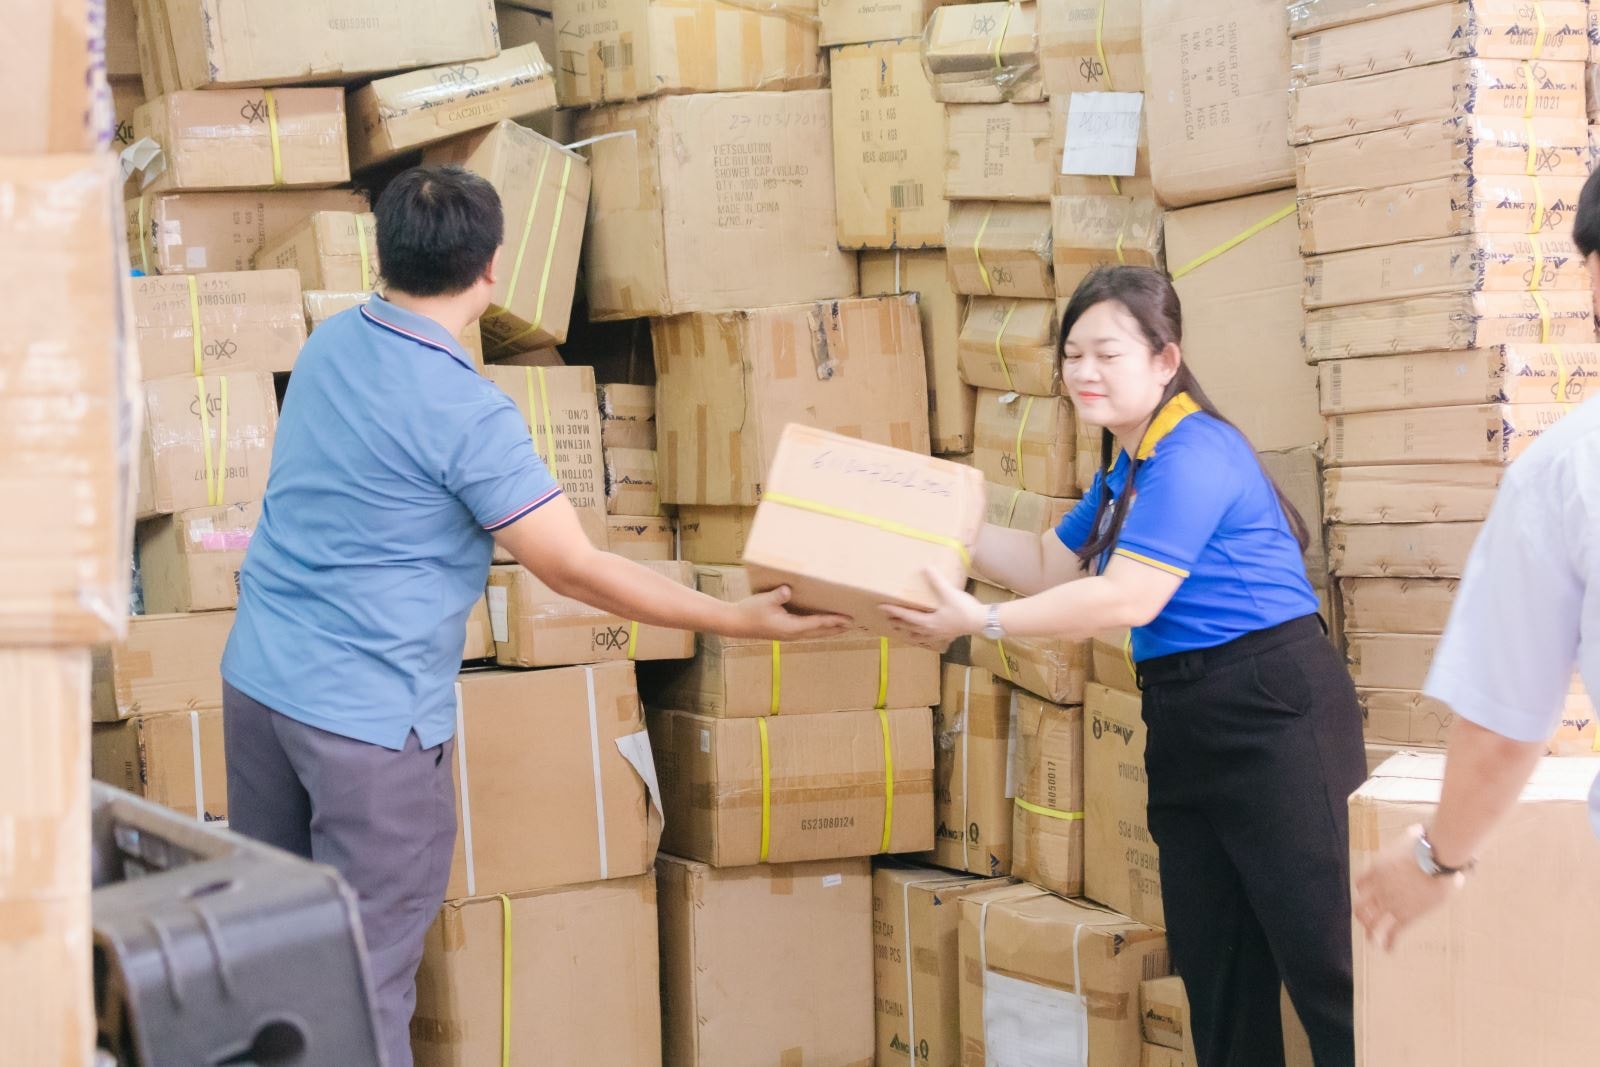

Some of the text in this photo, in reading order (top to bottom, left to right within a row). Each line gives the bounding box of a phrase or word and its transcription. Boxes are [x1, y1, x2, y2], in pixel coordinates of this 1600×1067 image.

[714, 167, 750, 179] SHOWER
[754, 167, 771, 177] CAP
[717, 204, 741, 215] MADE
[756, 201, 780, 214] CHINA
[556, 424, 565, 435] IN
[567, 424, 590, 435] MADE
[555, 439, 592, 450] VIETNAM
[562, 469, 593, 480] COTTON
[561, 482, 594, 493] FLC QUY
[1118, 762, 1139, 783] CHINA
[801, 816, 855, 831] GS23080124
[1126, 848, 1141, 865] CAP
[882, 924, 894, 938] CAP
[890, 947, 901, 964] PCS
[919, 1038, 929, 1062] Q
